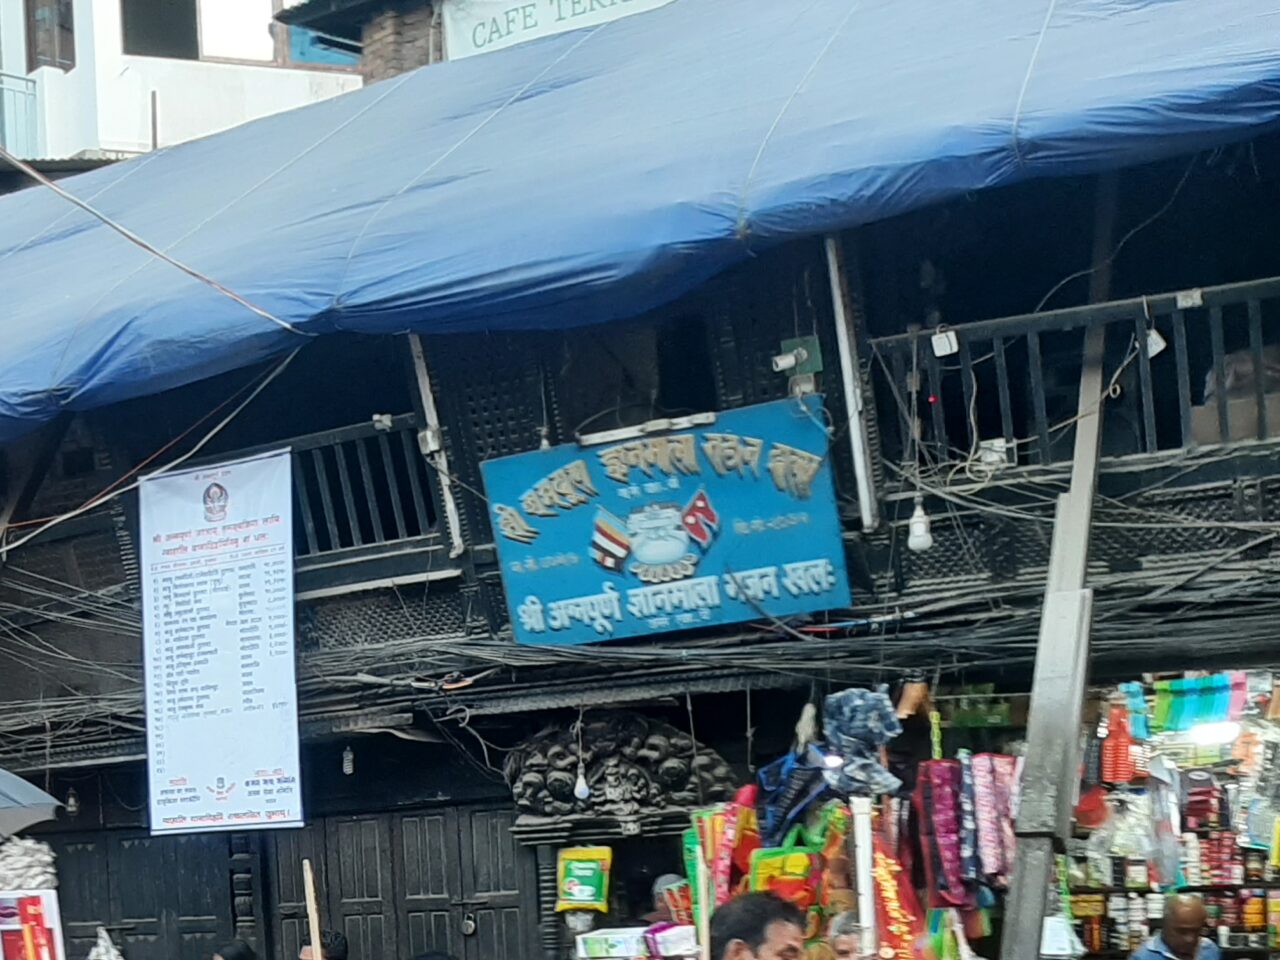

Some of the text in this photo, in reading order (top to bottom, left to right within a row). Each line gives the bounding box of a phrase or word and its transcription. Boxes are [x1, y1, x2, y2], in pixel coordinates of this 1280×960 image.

[472, 0, 633, 48] CAFE TE
[517, 594, 547, 634] श्री
[548, 581, 623, 636] अन्नपूर्ण
[627, 575, 722, 619] ज्ञानमाला
[724, 564, 781, 602] भजन
